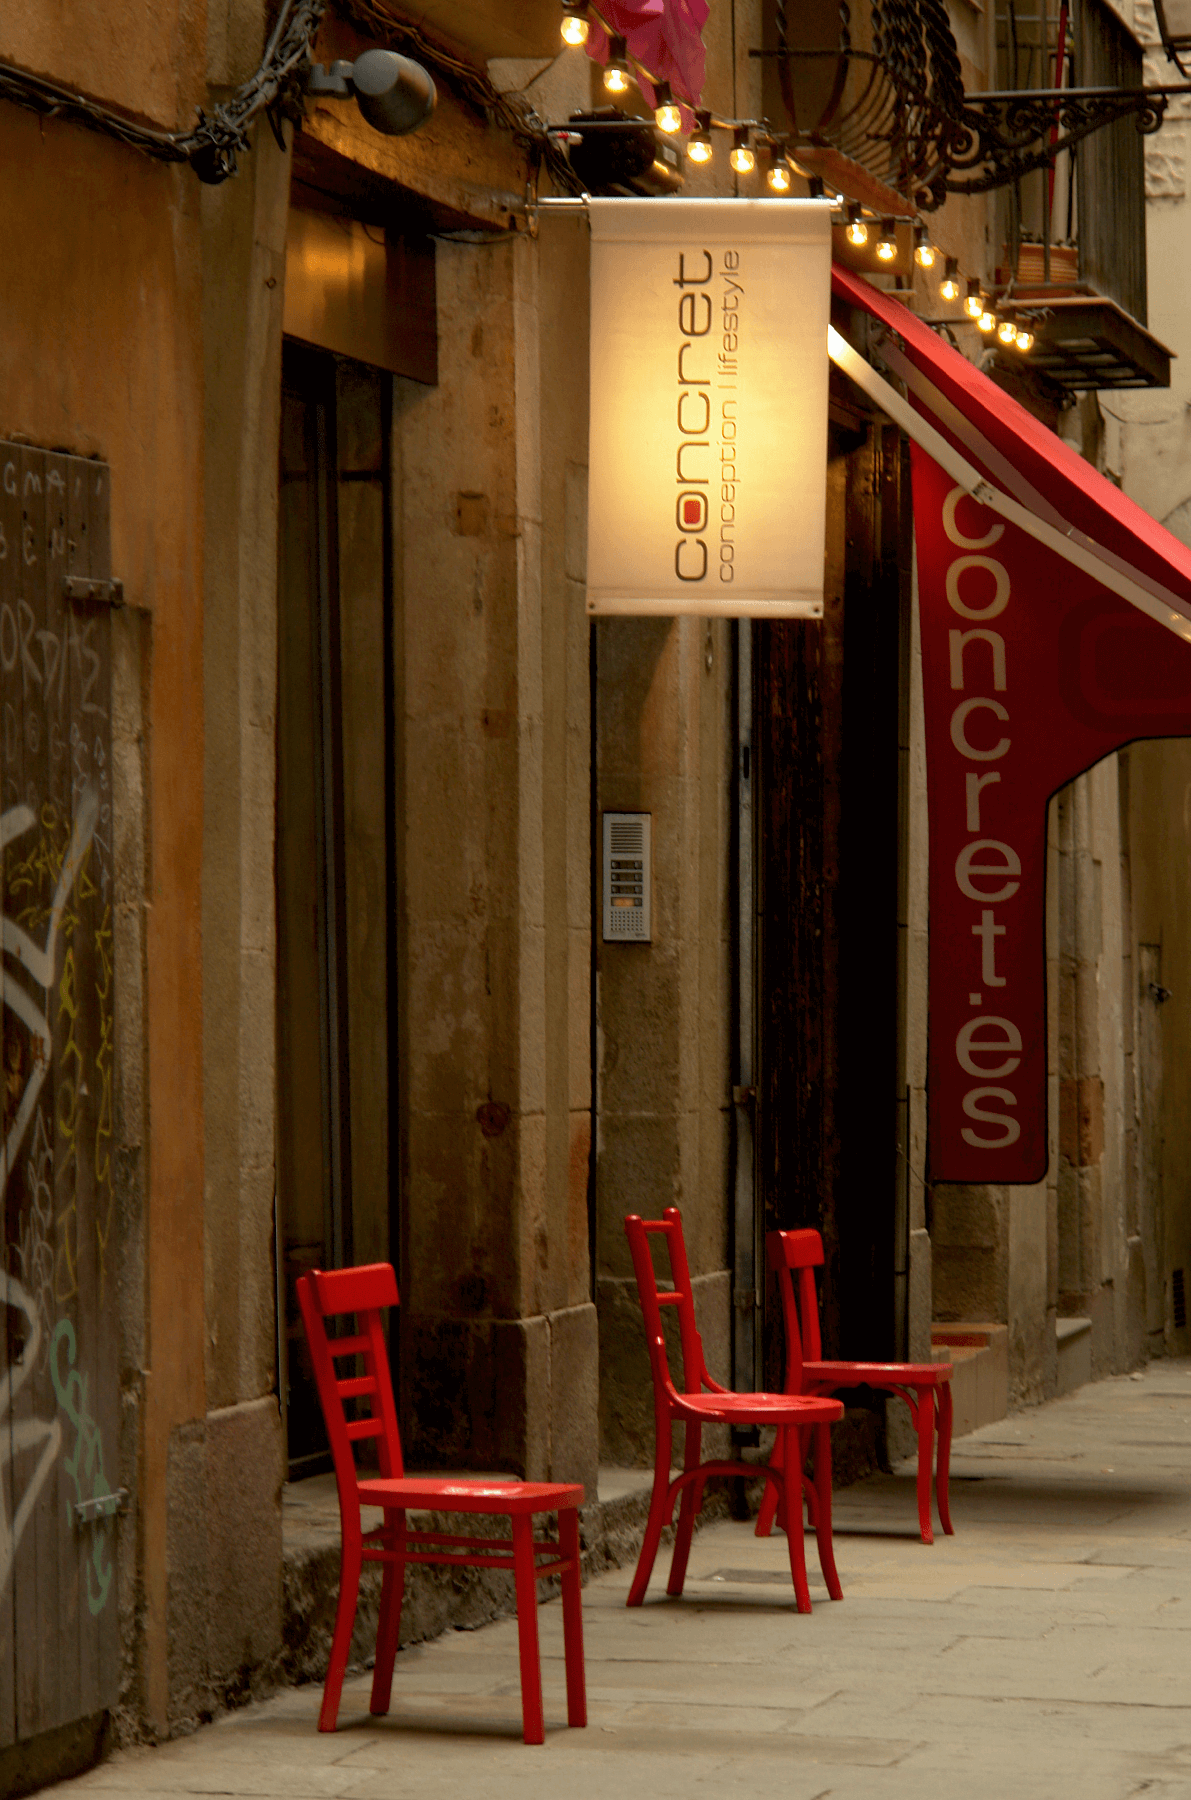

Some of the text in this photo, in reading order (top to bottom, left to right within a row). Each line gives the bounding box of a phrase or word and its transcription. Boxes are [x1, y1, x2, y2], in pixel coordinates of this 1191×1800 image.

[673, 249, 713, 583] concret
[718, 249, 745, 584] conception lifestyle
